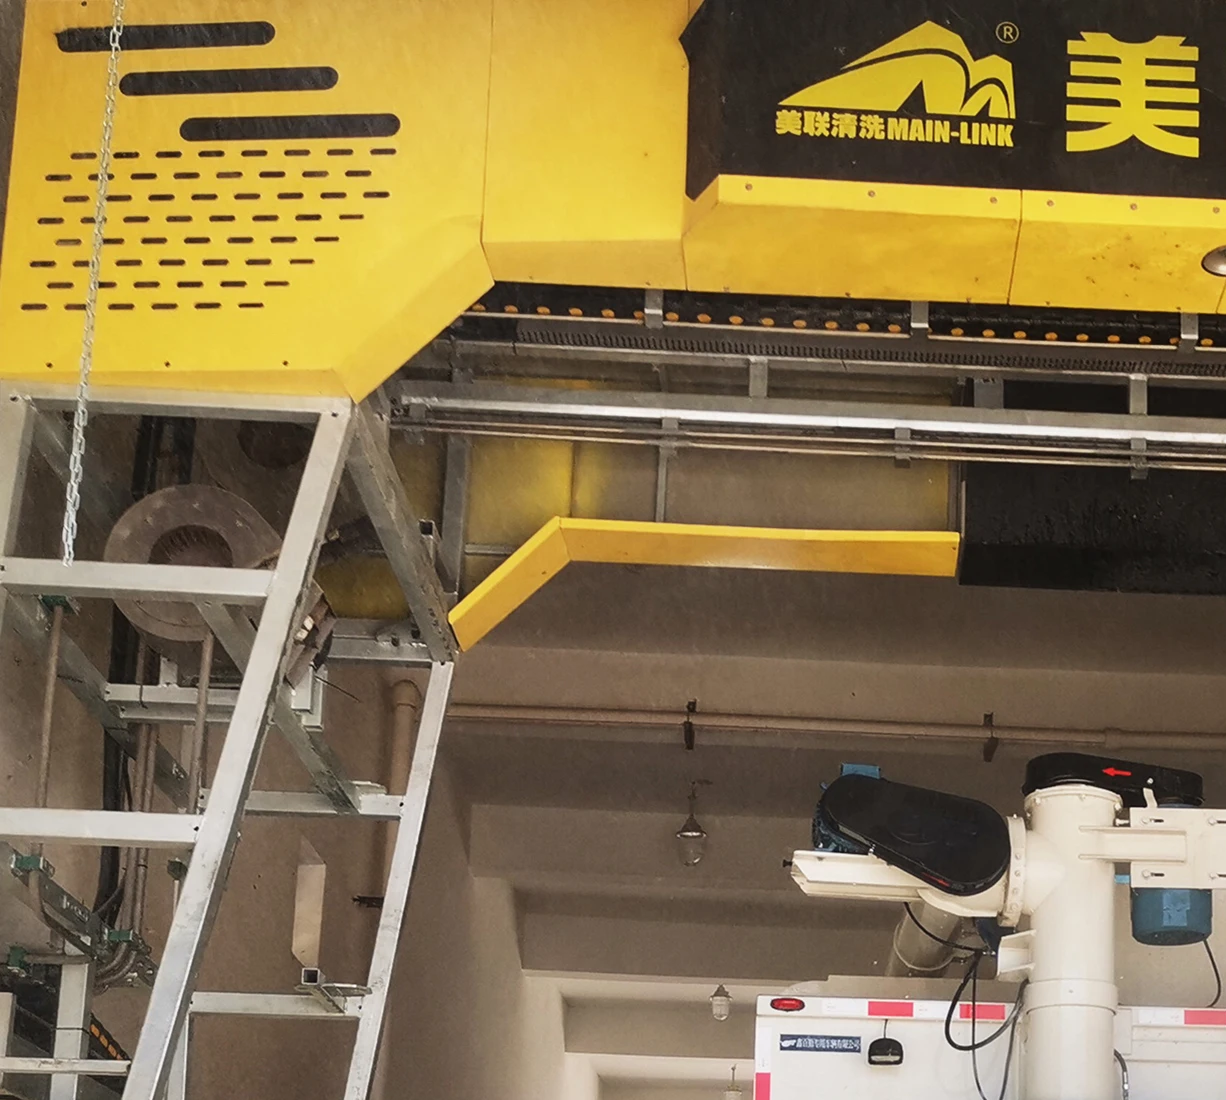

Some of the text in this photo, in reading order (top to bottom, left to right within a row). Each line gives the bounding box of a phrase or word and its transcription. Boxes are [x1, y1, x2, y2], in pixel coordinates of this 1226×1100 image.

[775, 109, 1014, 147] 美联清洗 MAIN-LINK
